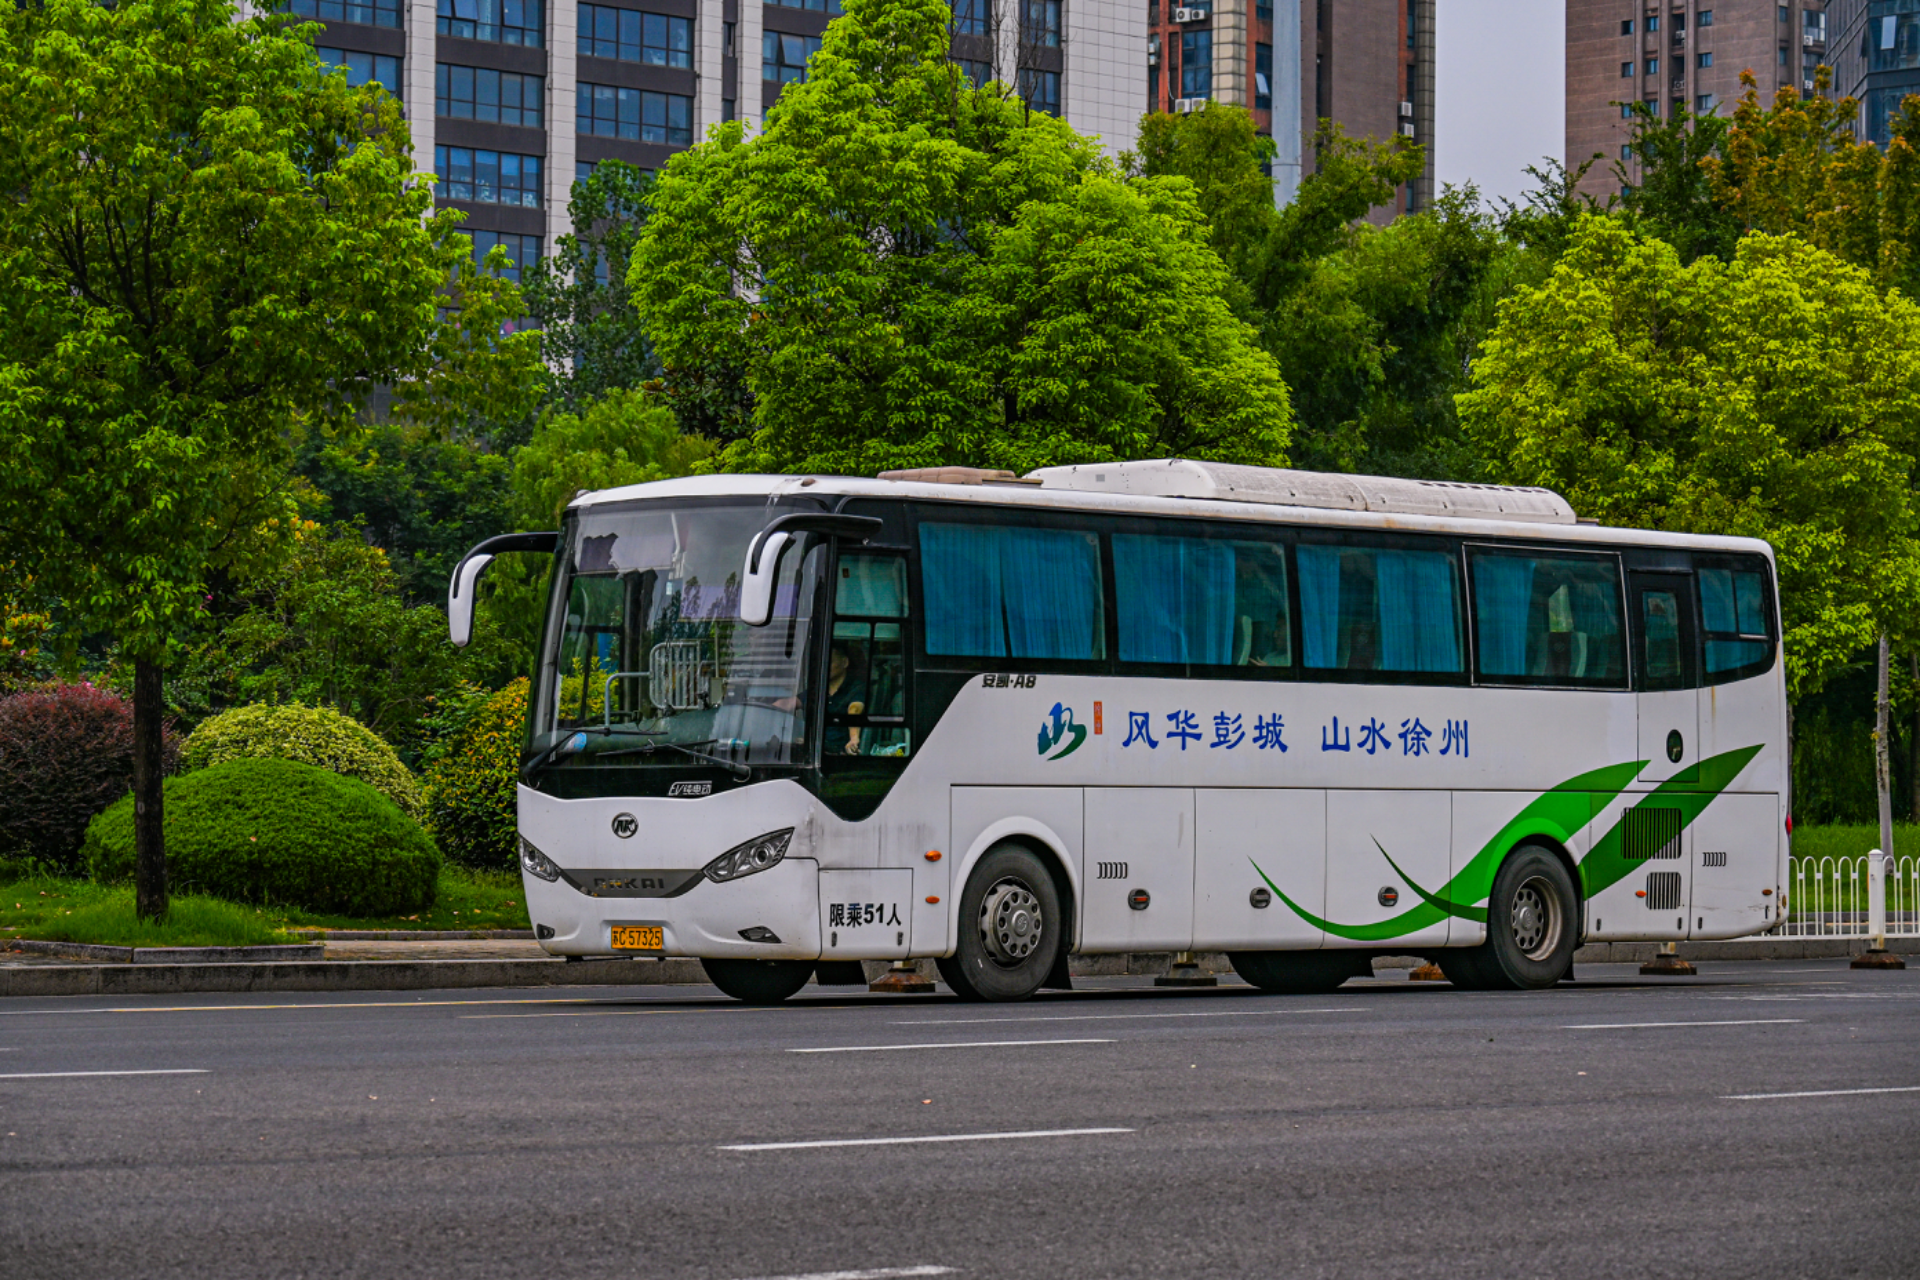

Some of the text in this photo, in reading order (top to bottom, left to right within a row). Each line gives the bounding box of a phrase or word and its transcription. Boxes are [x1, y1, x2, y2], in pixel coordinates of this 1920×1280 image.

[1122, 709, 1289, 753] 风华彭城
[1321, 715, 1470, 758] 山水徐州
[593, 877, 665, 890] ANKAI
[829, 902, 902, 928] 限乘51人
